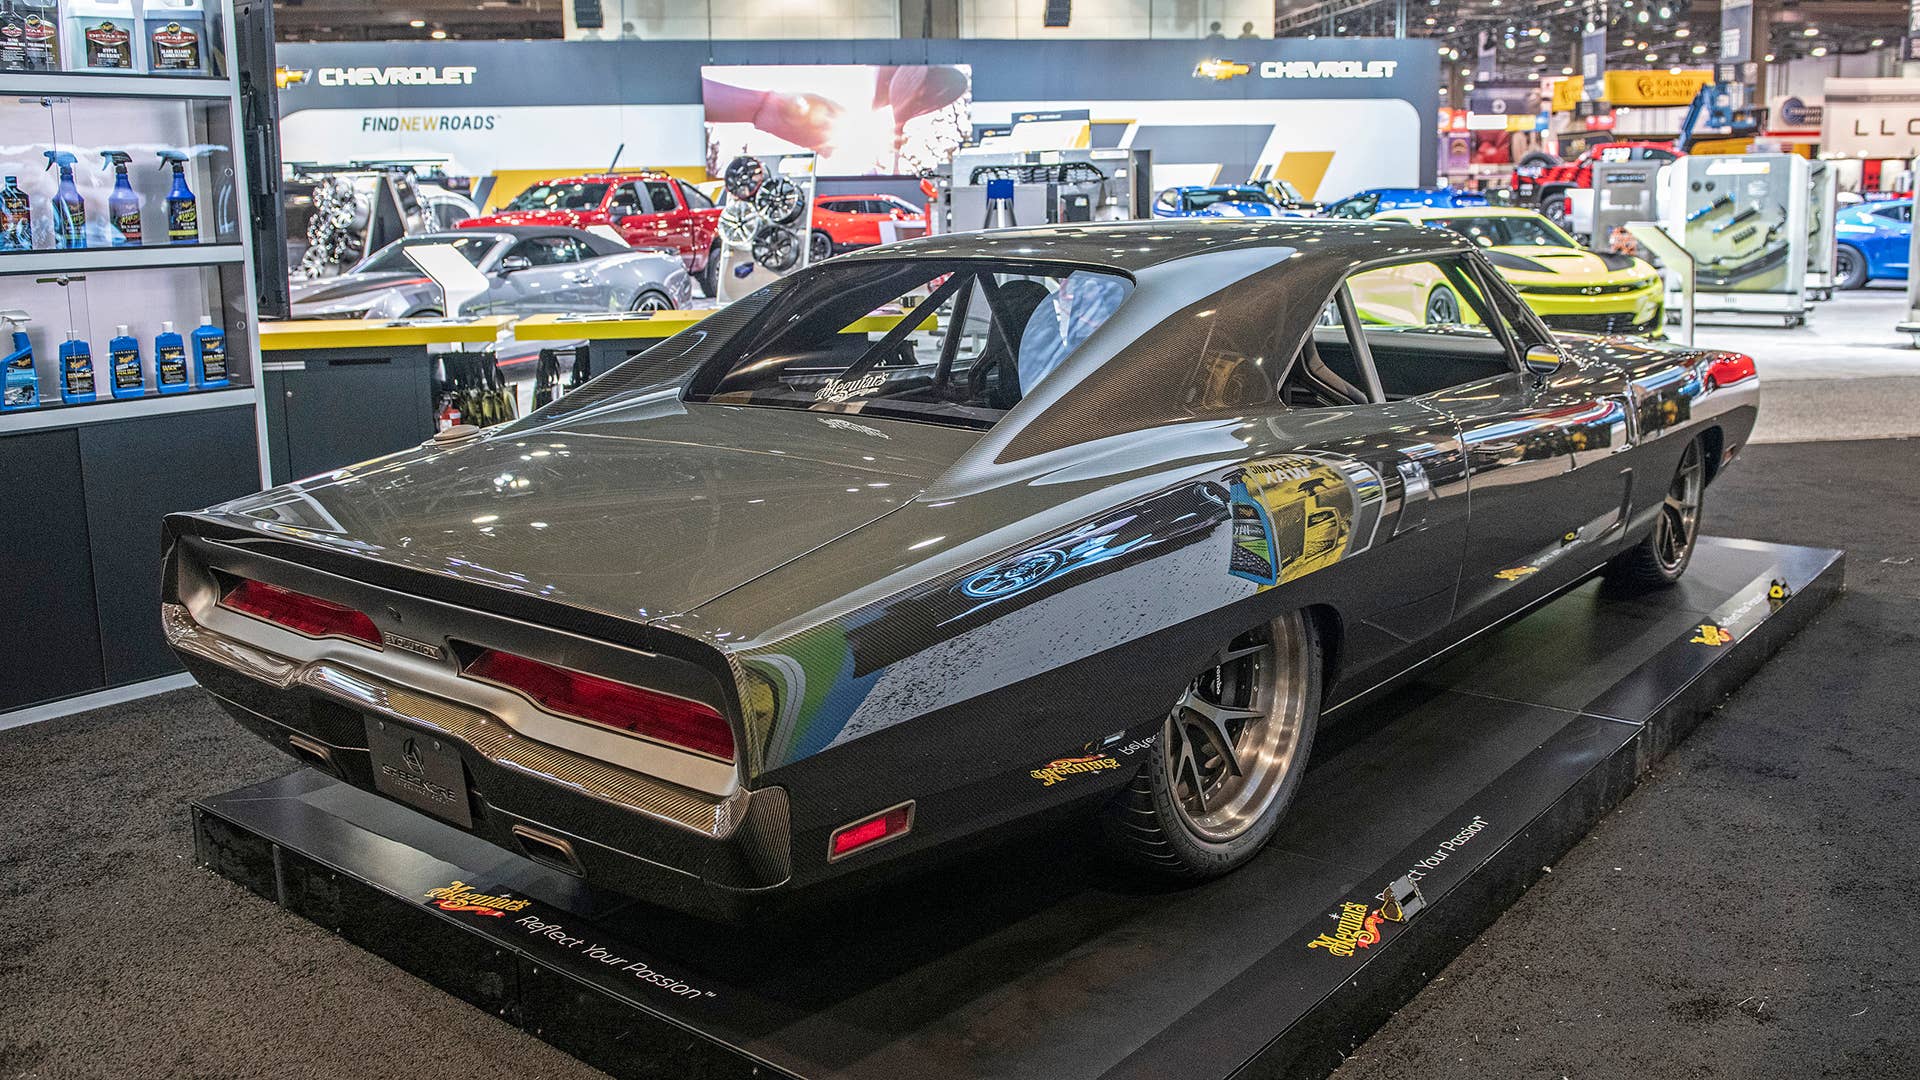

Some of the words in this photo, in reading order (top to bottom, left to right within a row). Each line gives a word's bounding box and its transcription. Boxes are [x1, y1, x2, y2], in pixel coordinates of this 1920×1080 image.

[318, 66, 477, 86] CHEVROLET
[1260, 60, 1398, 79] CHEVROLET
[1657, 79, 1693, 88] GRAND
[1657, 87, 1699, 97] GENERA
[815, 372, 889, 402] Meguiar's
[1414, 849, 1451, 870] Your
[424, 880, 532, 911] Meguiar's
[1307, 901, 1375, 957] Meguiar's
[515, 915, 584, 948] Reflect
[581, 943, 628, 966] Your
